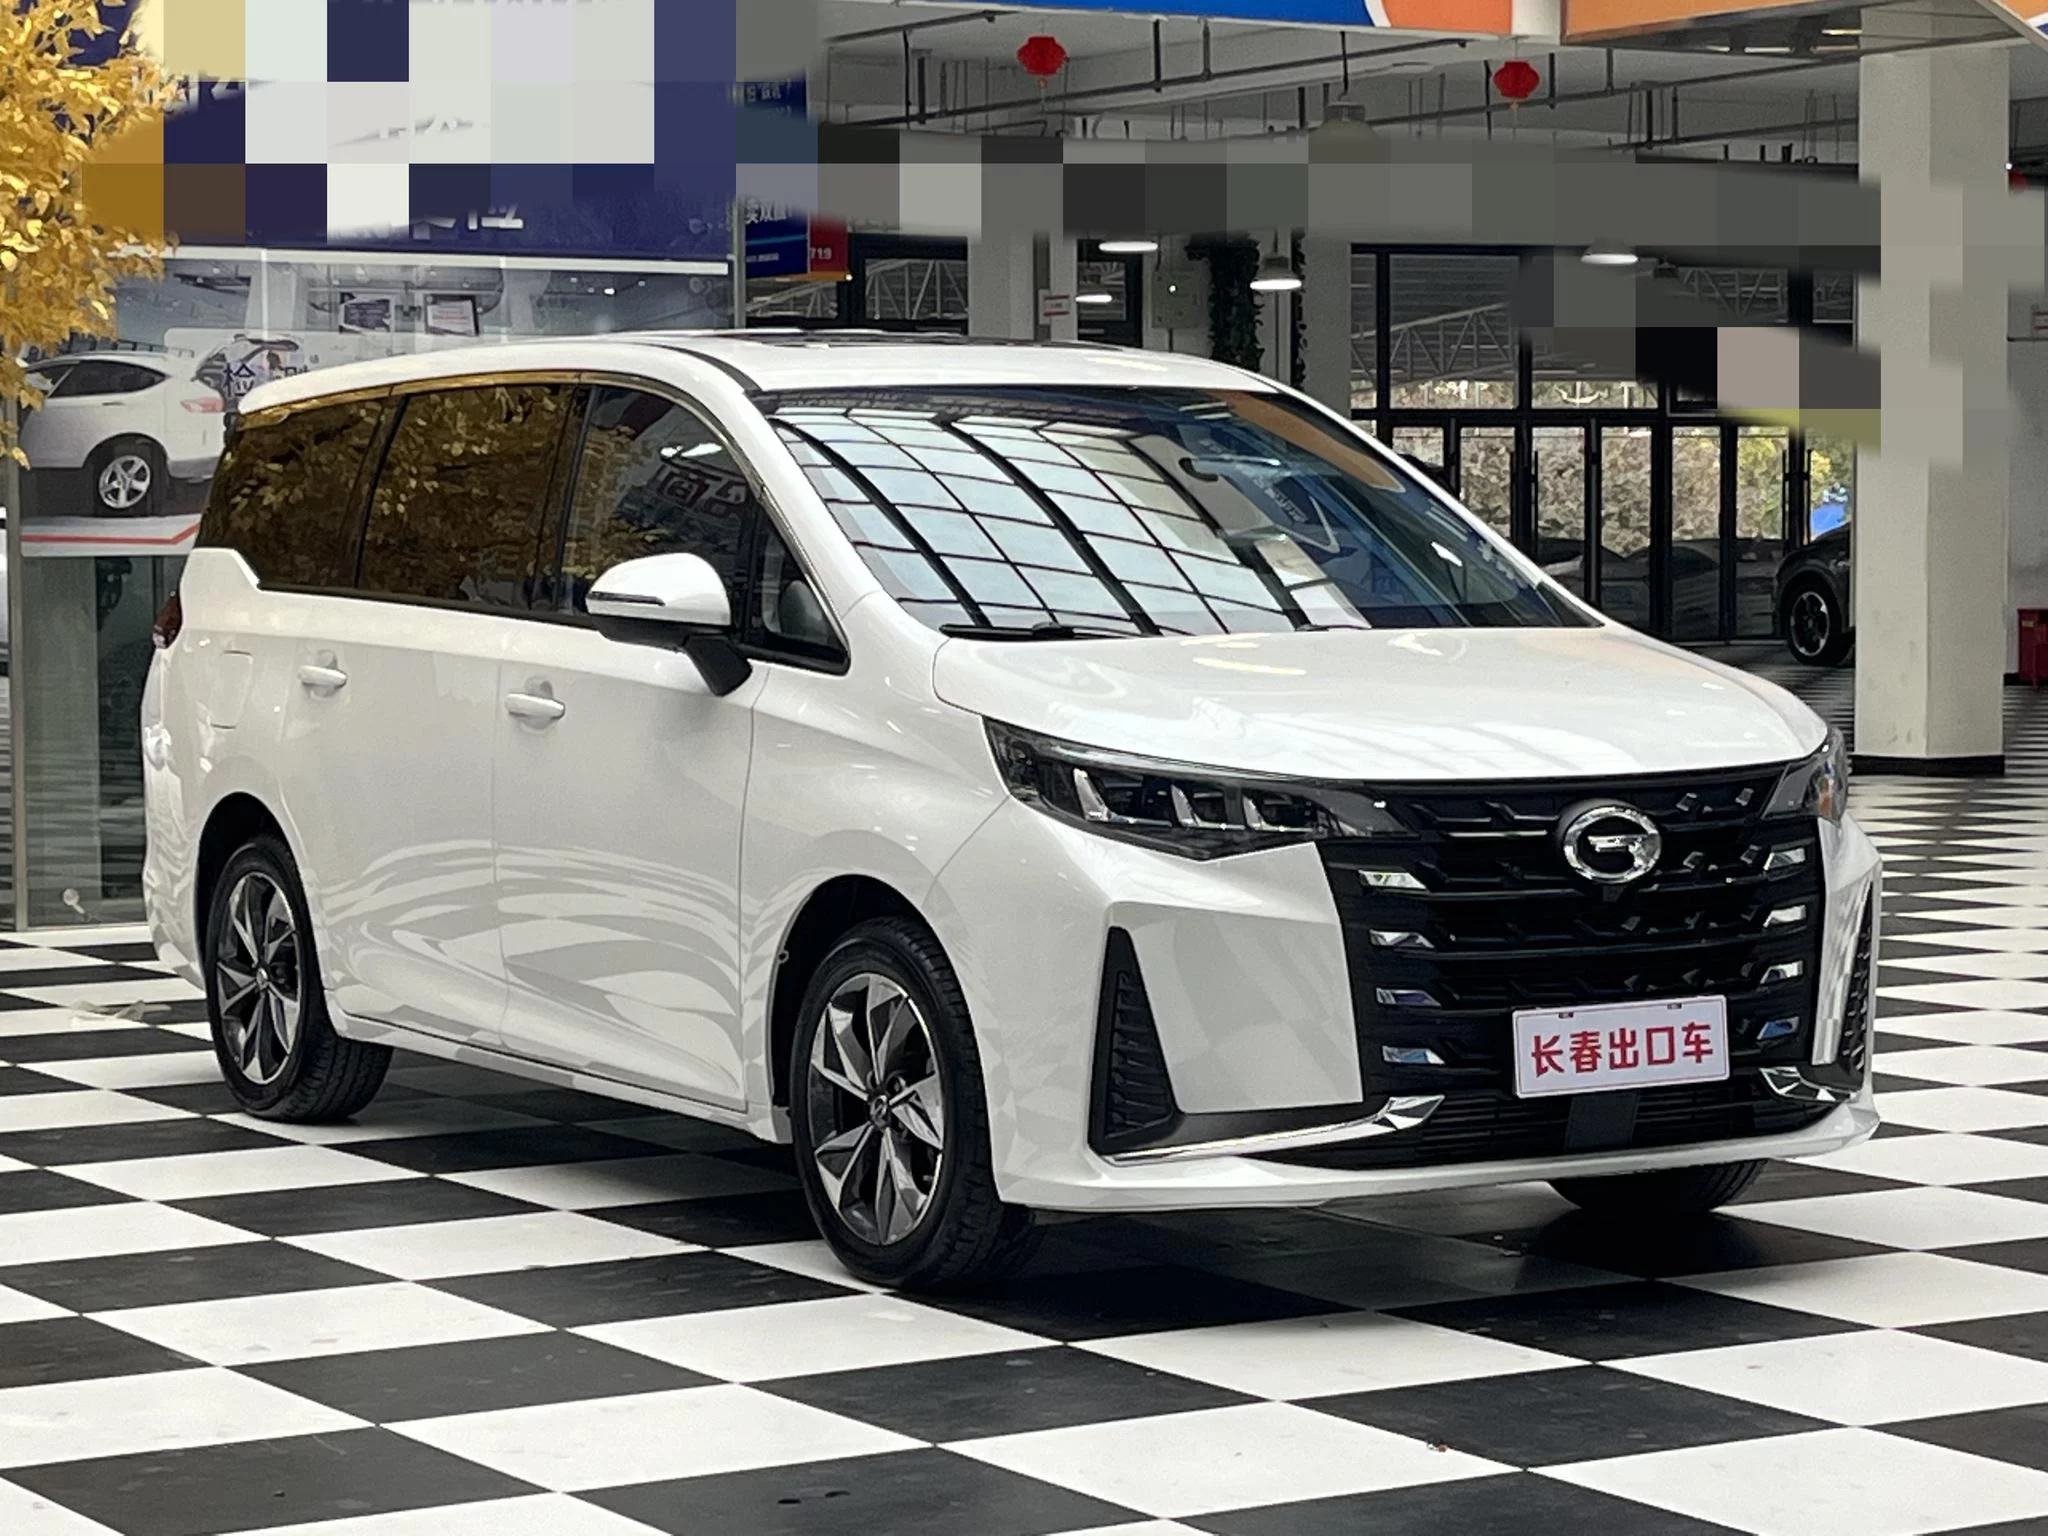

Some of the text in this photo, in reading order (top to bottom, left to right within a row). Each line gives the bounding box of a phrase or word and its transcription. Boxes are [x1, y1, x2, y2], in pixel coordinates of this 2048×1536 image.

[1531, 1021, 1714, 1078] 长春出口车
